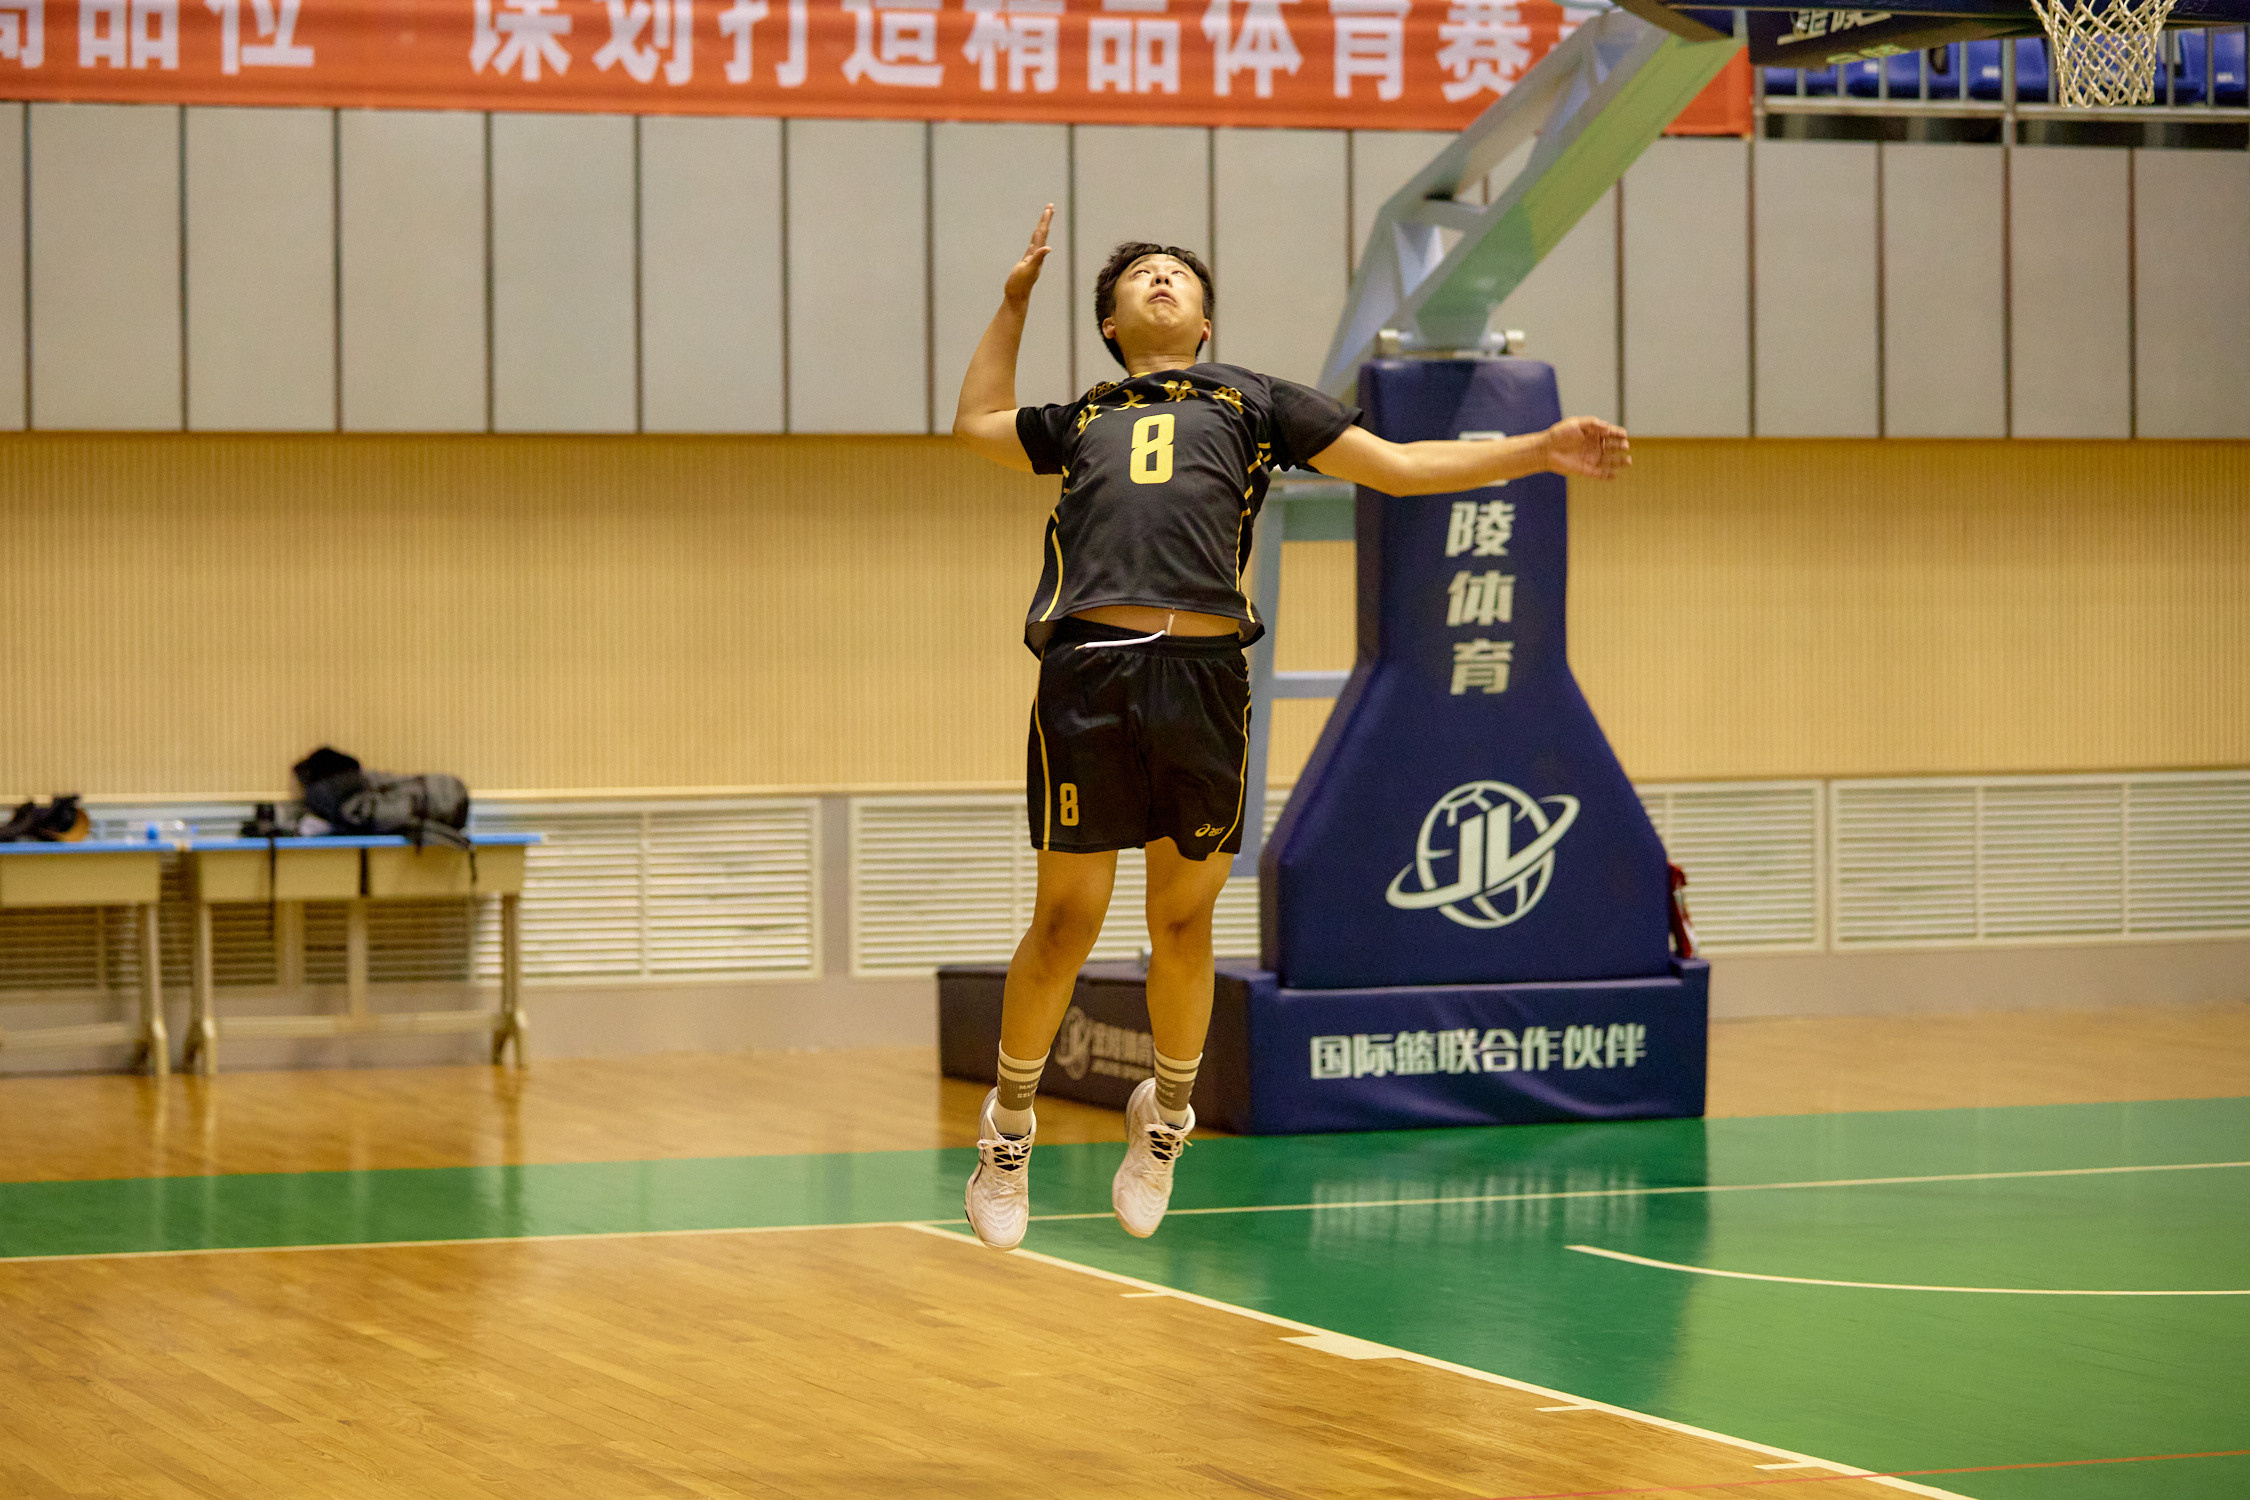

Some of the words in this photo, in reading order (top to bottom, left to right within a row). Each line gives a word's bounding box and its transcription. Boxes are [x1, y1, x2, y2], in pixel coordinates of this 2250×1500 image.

[469, 0, 1600, 103] 谋划打造精品体育赛
[1130, 413, 1175, 485] 8
[1445, 431, 1516, 696] 陵体育
[1059, 782, 1080, 827] 8
[1309, 1022, 1647, 1080] 国际篮联合作伙伴
